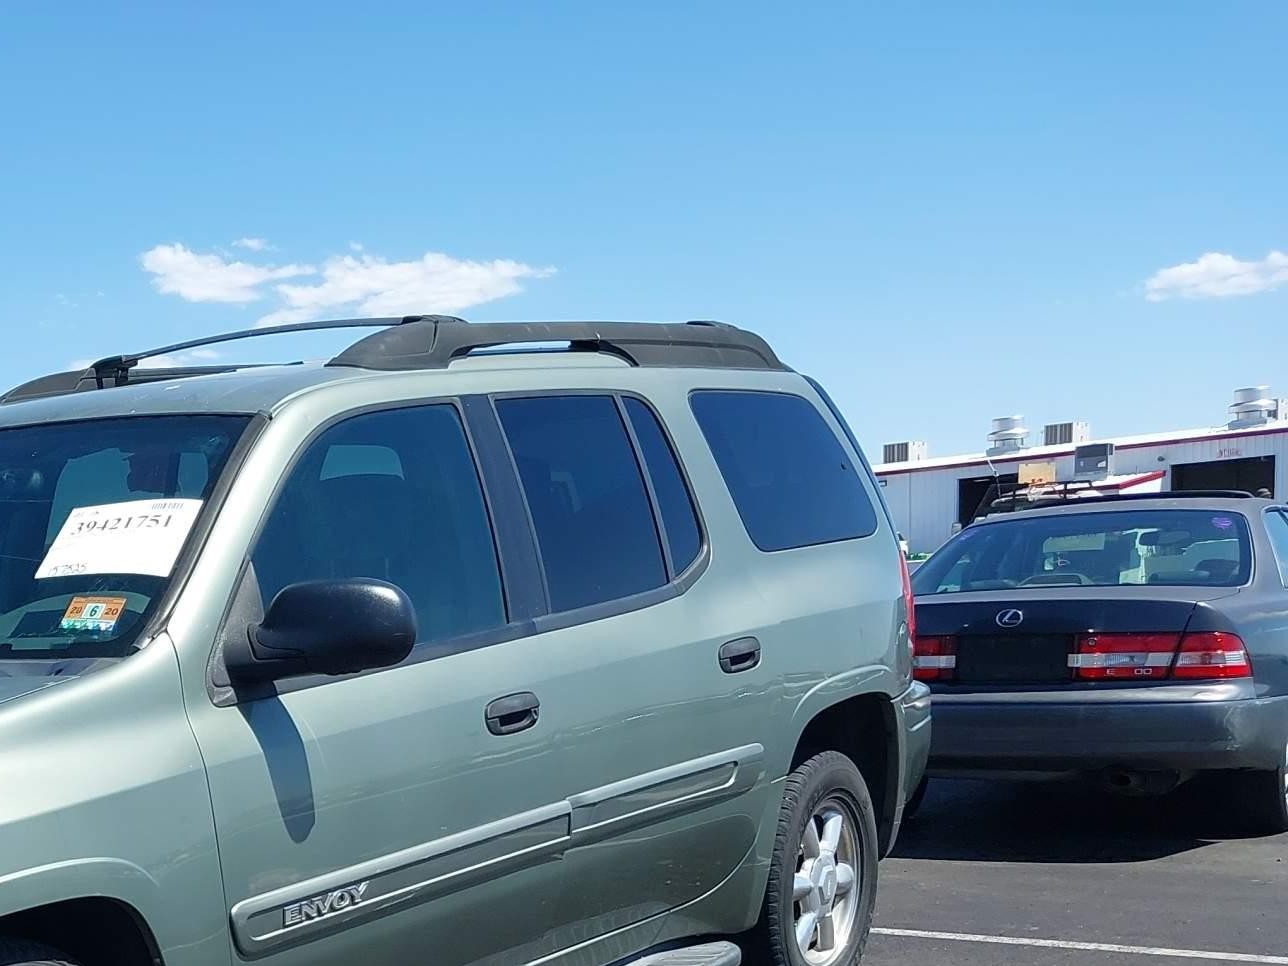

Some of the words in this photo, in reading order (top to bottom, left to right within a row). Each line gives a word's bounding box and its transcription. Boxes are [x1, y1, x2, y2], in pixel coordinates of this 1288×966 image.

[71, 514, 173, 535] 39421751
[90, 605, 99, 617] 6
[104, 607, 119, 616] 20
[284, 881, 369, 925] ENVOY
